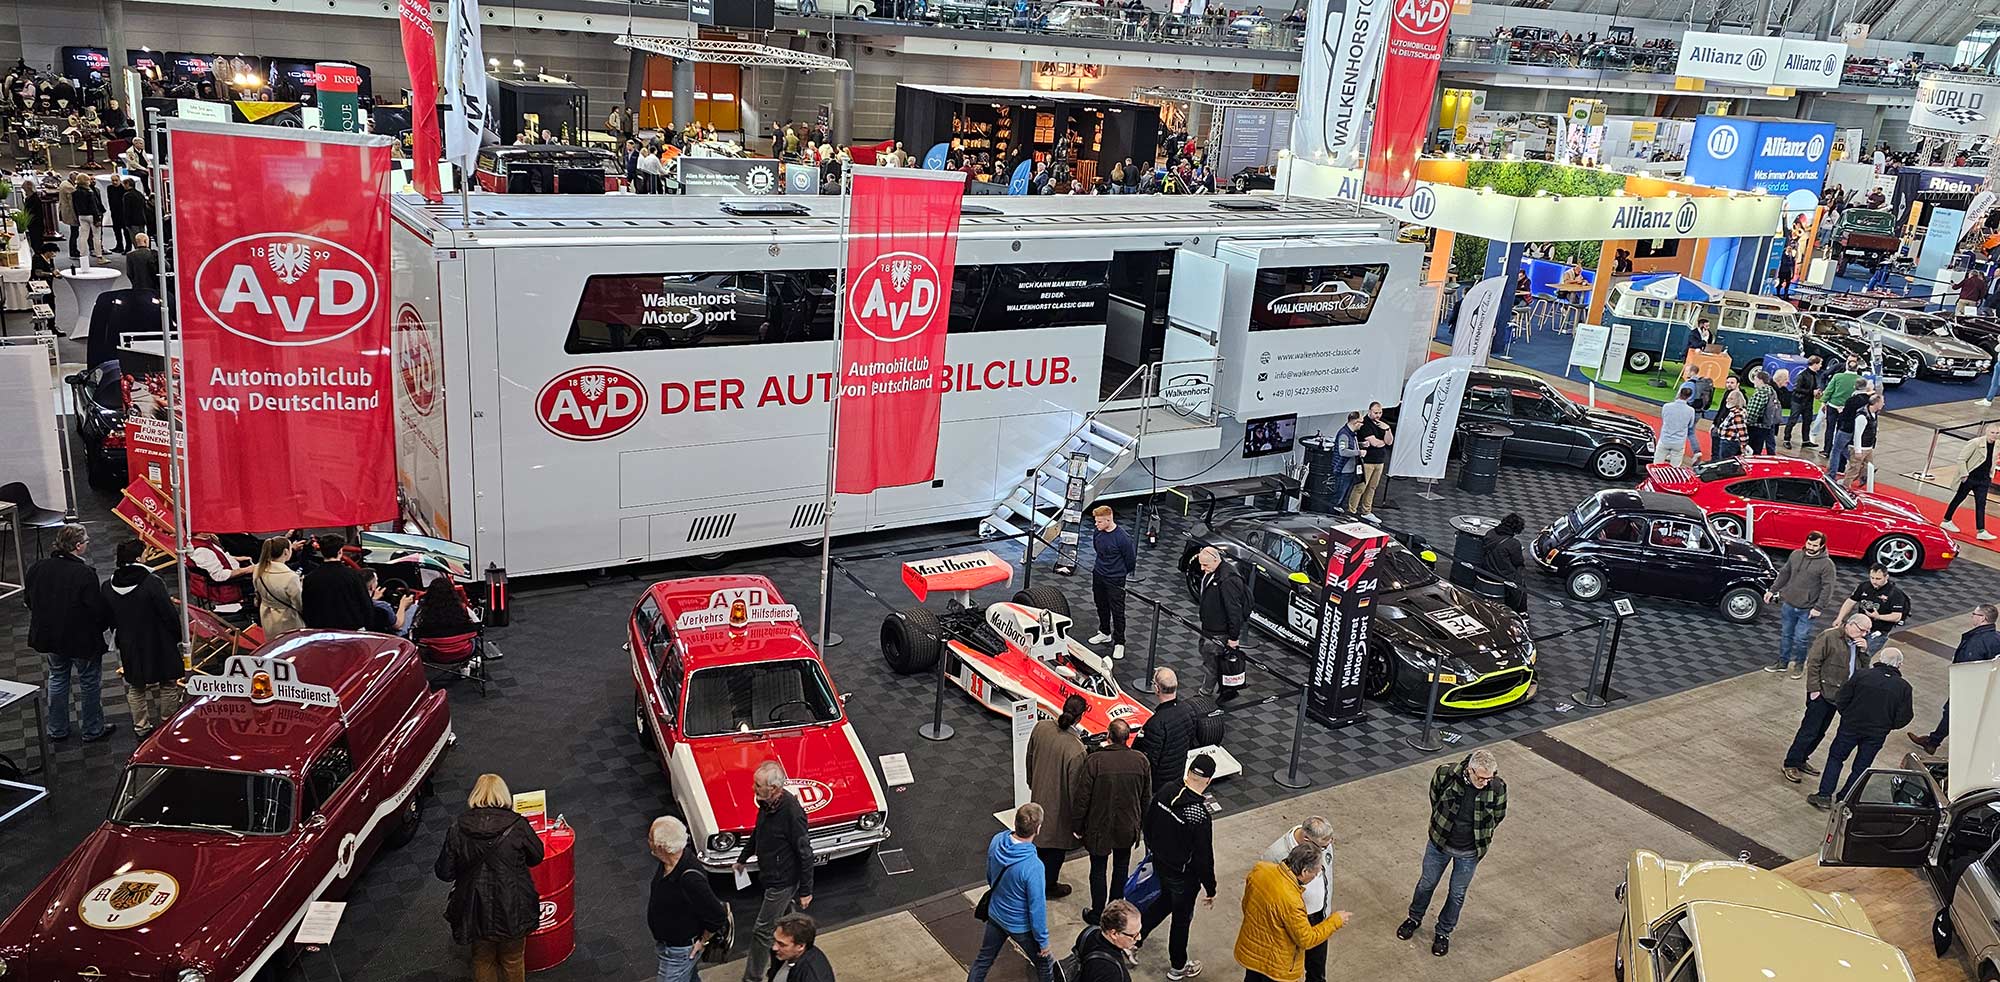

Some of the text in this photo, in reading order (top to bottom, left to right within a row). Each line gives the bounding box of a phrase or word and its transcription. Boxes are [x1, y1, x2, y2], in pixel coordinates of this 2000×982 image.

[1689, 46, 1744, 66] Allianz
[1784, 54, 1822, 72] Allianz
[334, 74, 356, 84] INFO
[1333, 7, 1372, 147] WALKENHORST
[1760, 136, 1808, 157] Allianz
[1754, 170, 1768, 180] Was
[1787, 170, 1797, 180] Du
[1930, 177, 1972, 194] Rhein
[1612, 206, 1673, 229] Allianz
[250, 247, 330, 261] 18 99
[880, 263, 922, 273] 18 99
[641, 292, 737, 308] Walkenhorst
[1006, 303, 1051, 312] WALKENHORST
[1273, 301, 1340, 315] WALKENHORST
[1277, 347, 1361, 361] www.walkenhorst-classic.de
[848, 355, 930, 377] Autmobilclub
[1274, 365, 1360, 380] info@walkenhorst-classic.de
[209, 367, 373, 387] Automobilclub
[568, 376, 619, 387] 18 99
[840, 374, 933, 397] von eutschland
[199, 389, 380, 412] von Deutschland
[660, 378, 745, 415] DER
[1165, 387, 1210, 398] Walkenhorst
[130, 417, 168, 428] DEIN TEAM
[1424, 402, 1445, 462] WALKENHORST
[911, 559, 987, 577] Marlboro
[1327, 572, 1350, 592] 34
[1356, 578, 1378, 594] 34
[682, 608, 794, 627] Verkehrs Hilfsdienst
[1294, 610, 1314, 637] 34
[1446, 618, 1476, 632] 34
[990, 611, 1027, 647] Marlboro
[1314, 602, 1335, 687] WALKENHORST
[1324, 606, 1343, 685] MOTORSPORT
[1341, 616, 1360, 689] Walkenhorst
[193, 679, 331, 703] Verkehrs Hilfsdienst
[971, 673, 984, 699] 11
